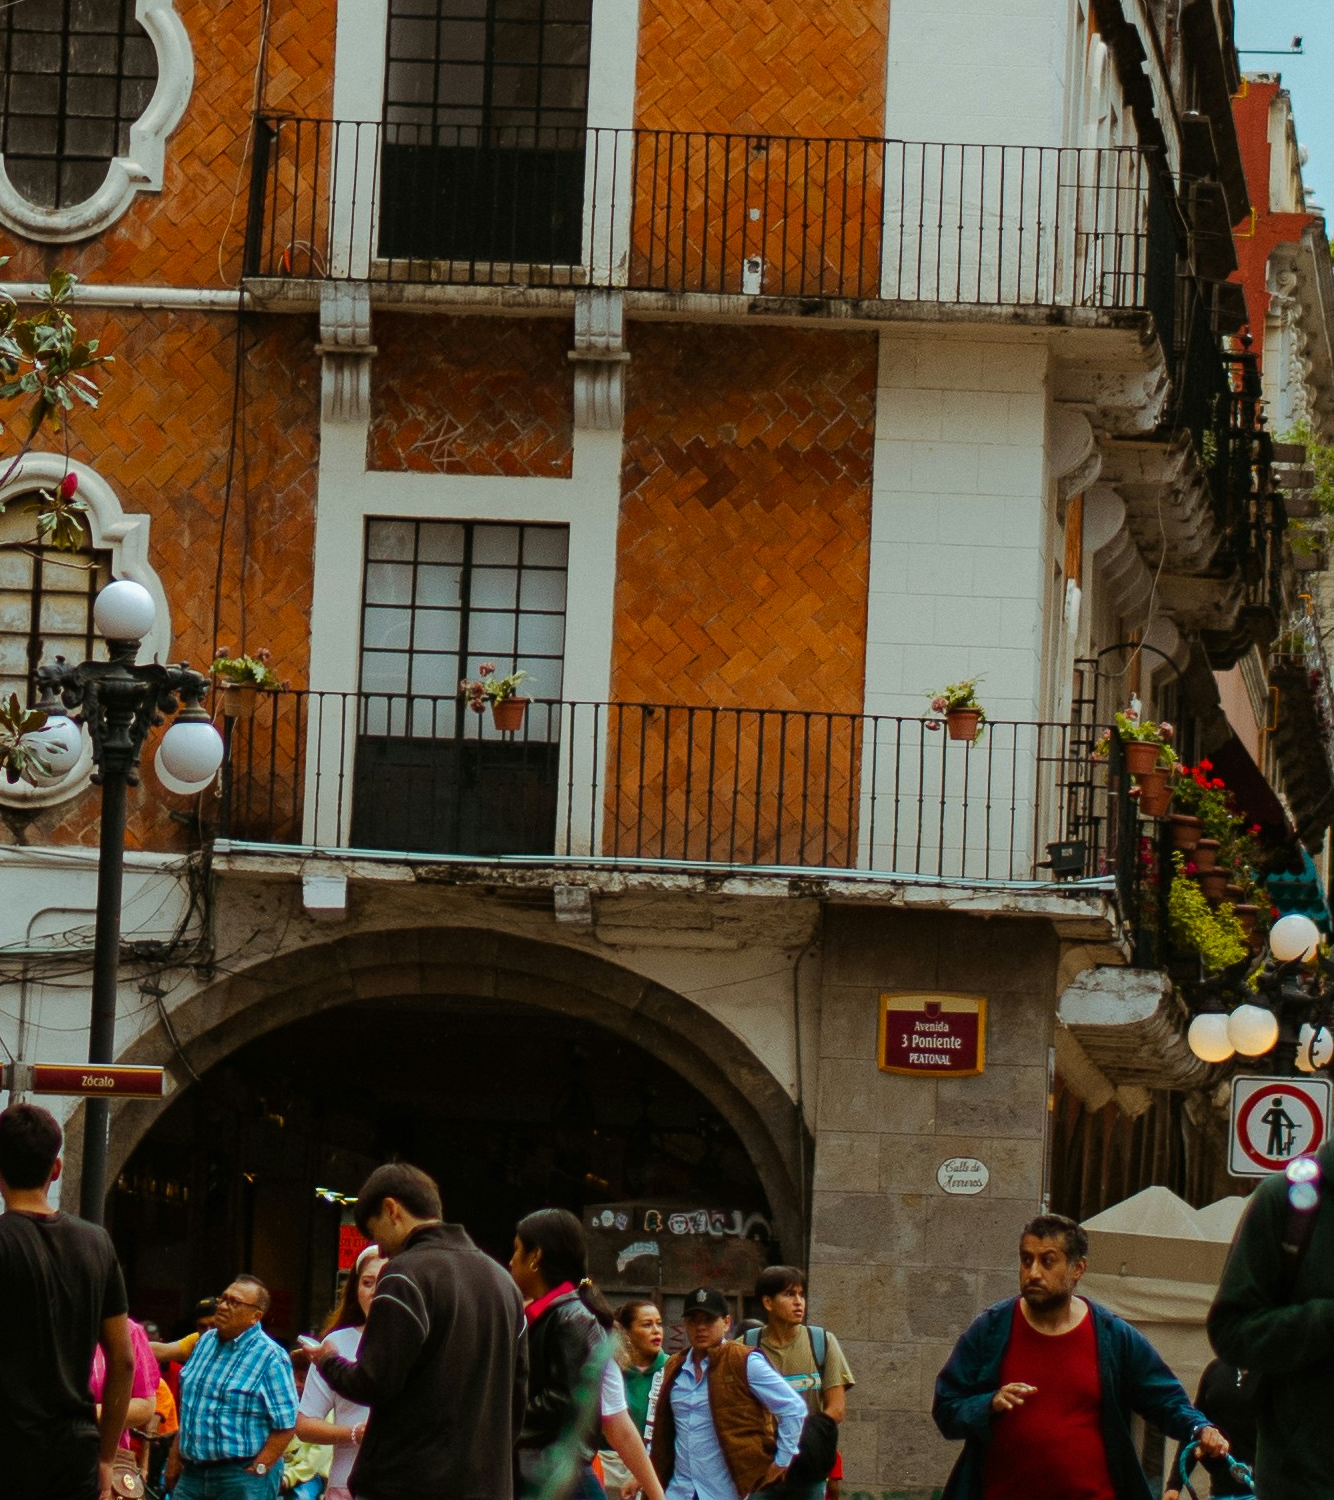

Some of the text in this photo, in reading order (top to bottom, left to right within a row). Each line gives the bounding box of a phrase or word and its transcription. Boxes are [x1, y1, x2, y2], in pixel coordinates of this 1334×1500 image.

[914, 1021, 949, 1032] Avenida
[901, 1034, 961, 1049] 3 Poniente
[909, 1053, 951, 1065] PEATONAL
[82, 1075, 115, 1087] Zócalo
